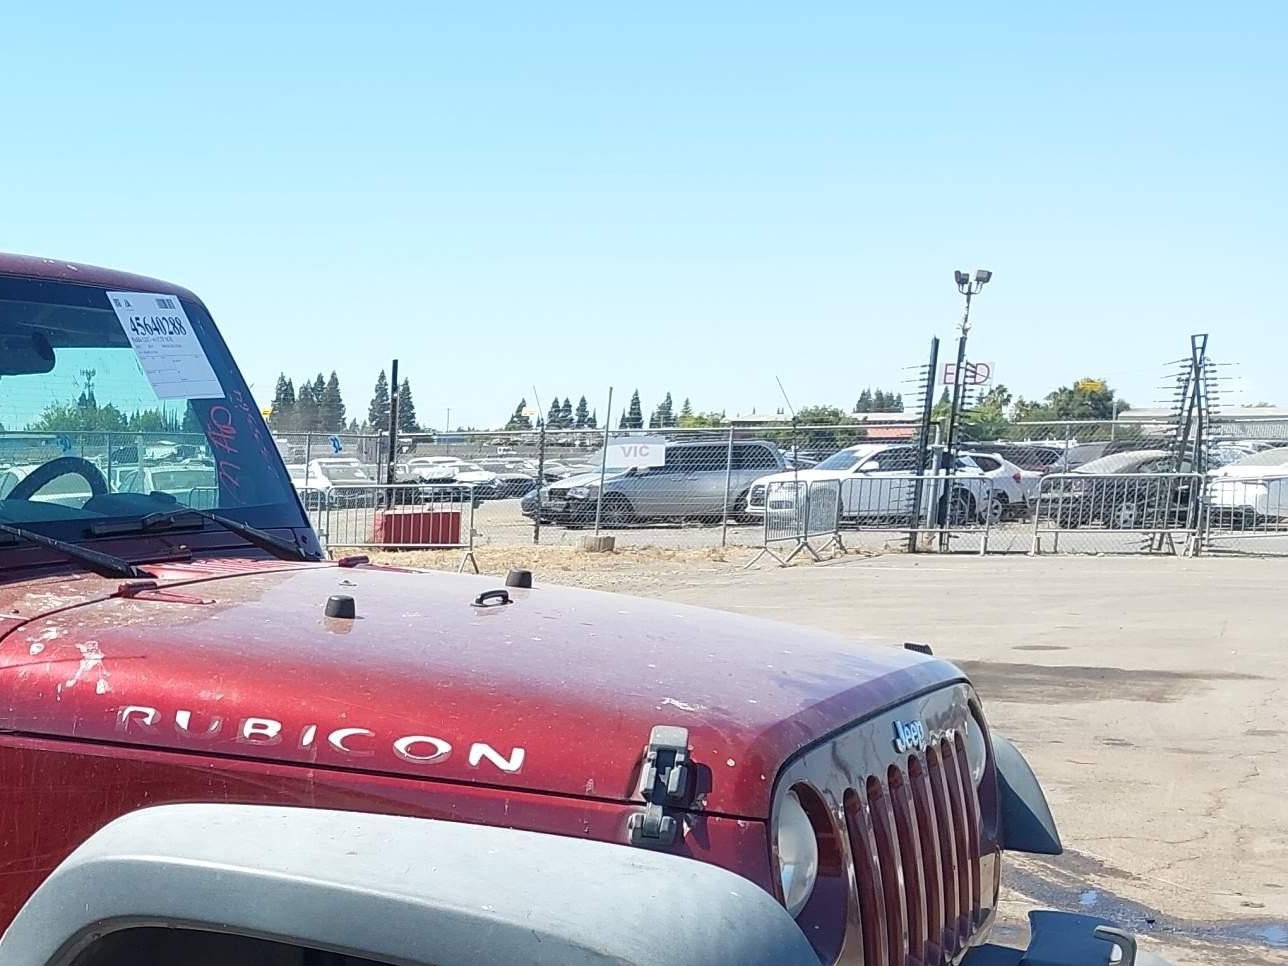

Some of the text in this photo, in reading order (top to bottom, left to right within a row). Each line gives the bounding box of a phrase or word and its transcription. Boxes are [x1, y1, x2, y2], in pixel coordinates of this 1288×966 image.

[129, 315, 187, 336] 45640288
[943, 362, 991, 386] ED
[620, 444, 649, 457] VIC
[116, 704, 527, 775] RUBICON
[893, 719, 927, 754] Jeep
